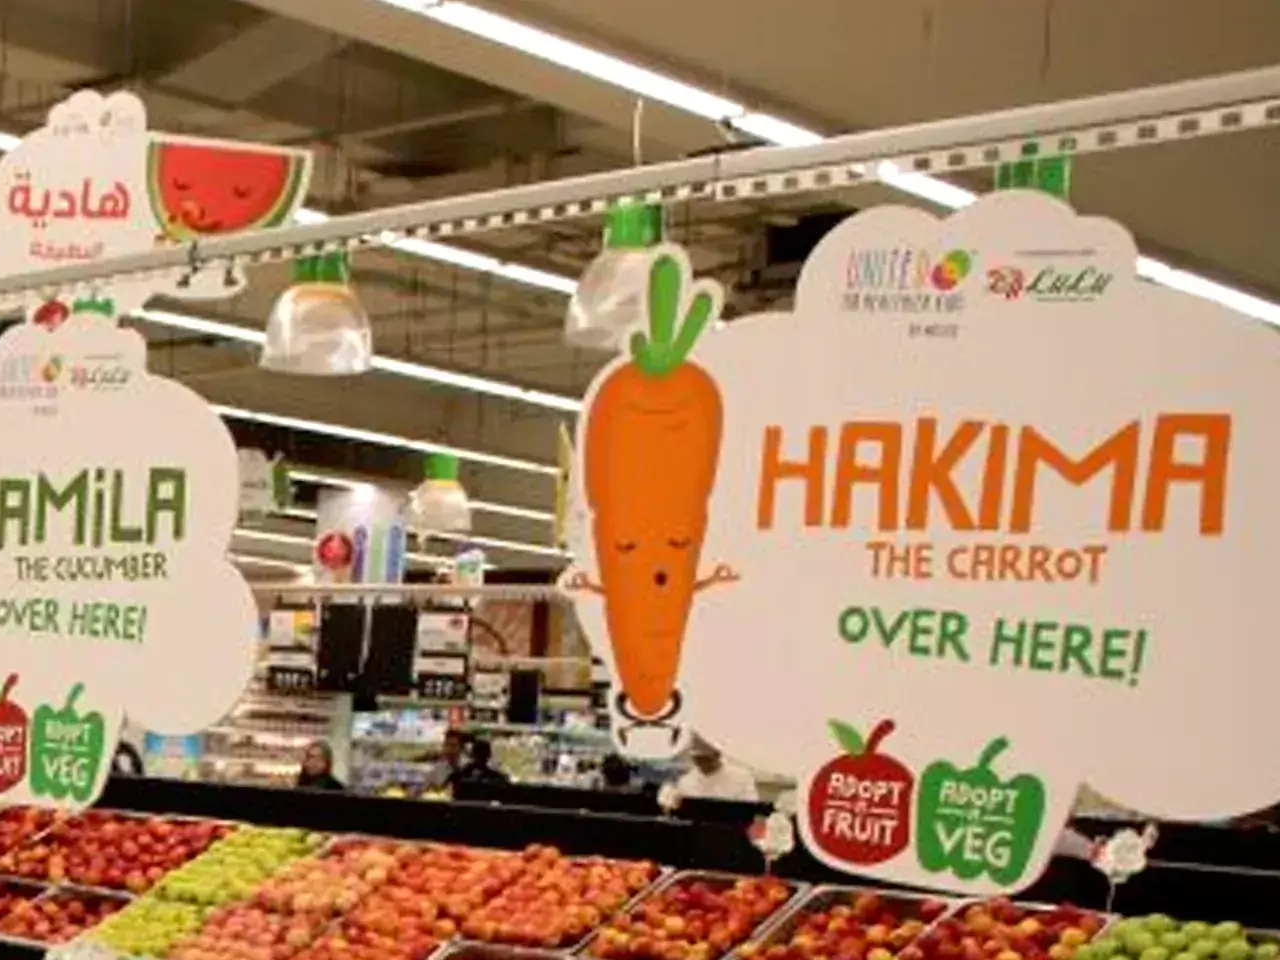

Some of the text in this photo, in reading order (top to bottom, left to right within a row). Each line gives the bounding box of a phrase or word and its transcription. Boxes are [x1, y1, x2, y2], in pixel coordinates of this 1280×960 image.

[8, 171, 131, 228] هادية
[757, 413, 1232, 535] HAKIMA
[15, 552, 169, 583] THE CUCUMBER
[867, 541, 1108, 583] THE CARROT
[69, 604, 148, 643] HERE!
[838, 605, 1148, 686] OVER HERE!
[41, 754, 92, 788] VEG
[827, 772, 907, 806] ADOPT
[939, 781, 1020, 814] ADOPT
[822, 808, 900, 846] FRUIT
[934, 820, 1015, 868] VEG
